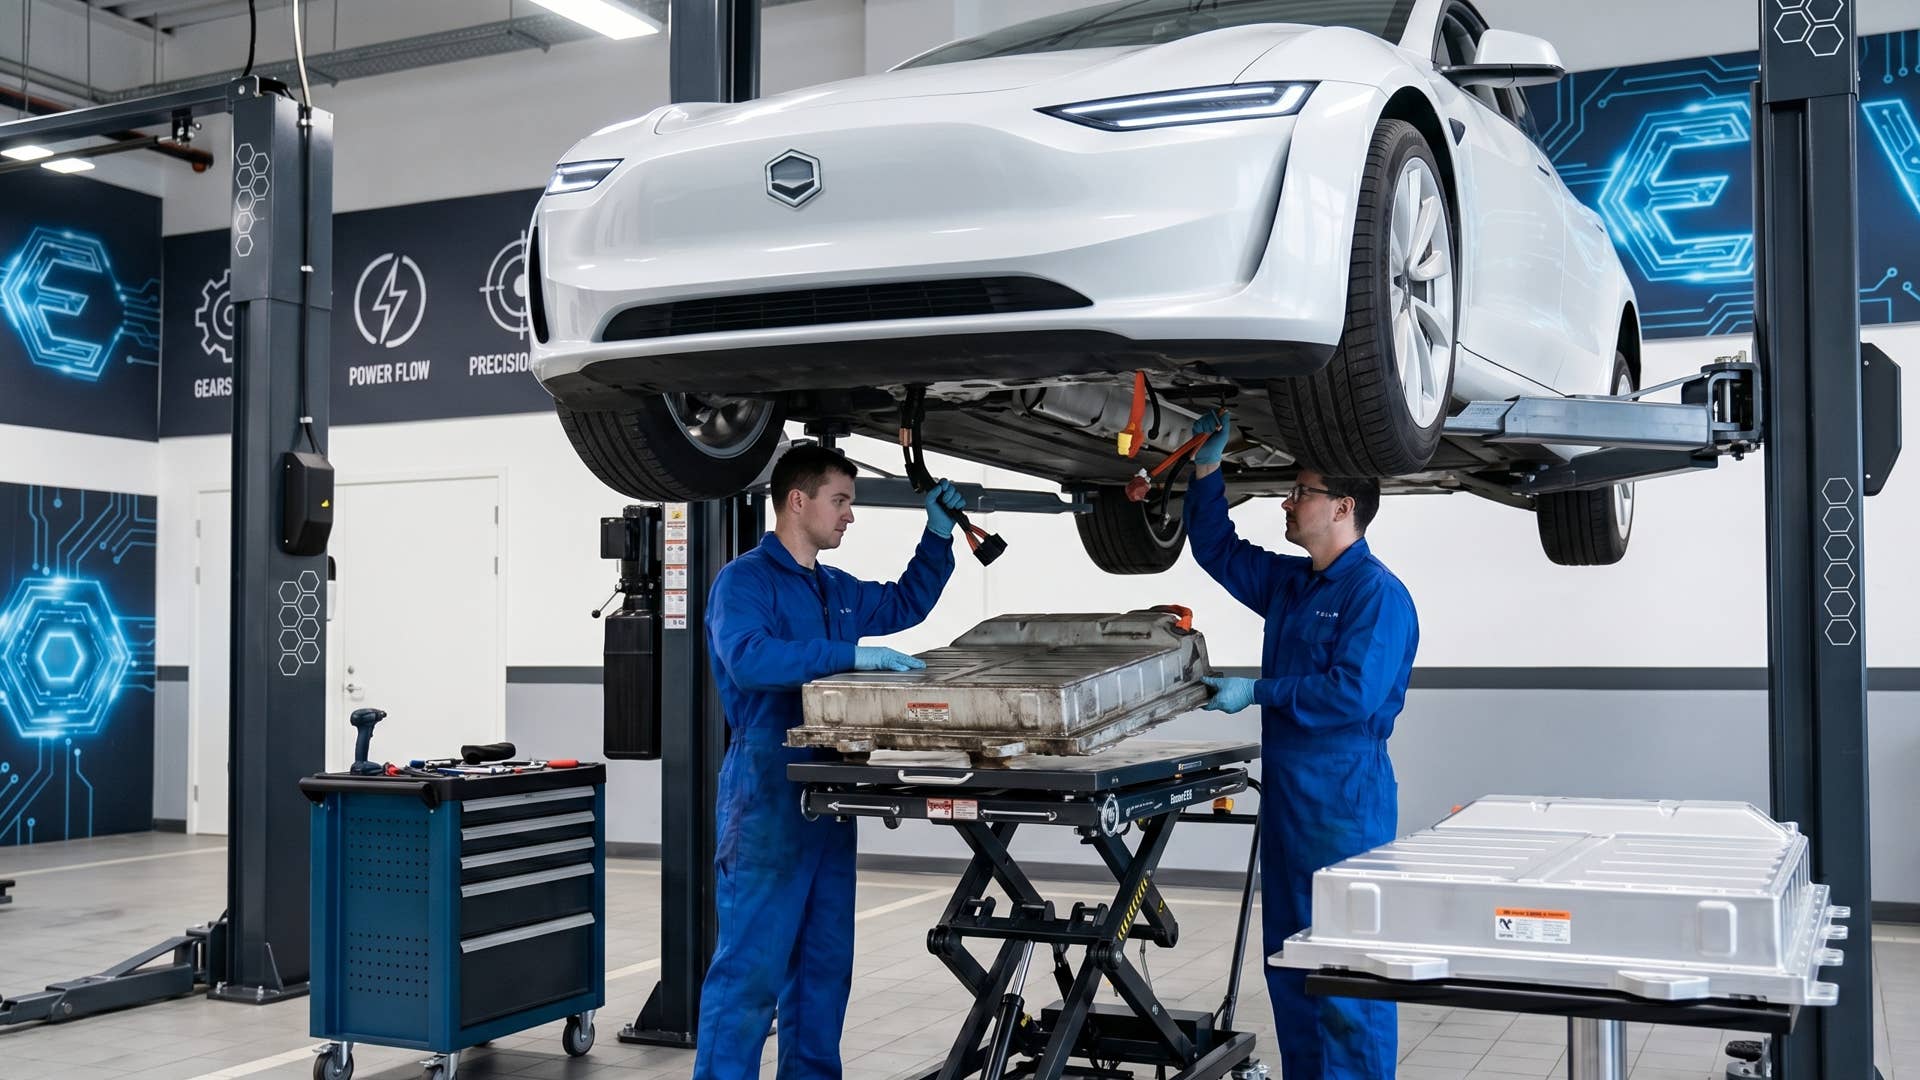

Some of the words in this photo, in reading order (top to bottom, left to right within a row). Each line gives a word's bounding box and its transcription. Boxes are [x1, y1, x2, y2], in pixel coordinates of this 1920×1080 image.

[349, 363, 393, 386] POWER
[395, 360, 431, 382] FLOW
[469, 351, 532, 376] PRECISIO
[194, 376, 233, 398] GEARS
